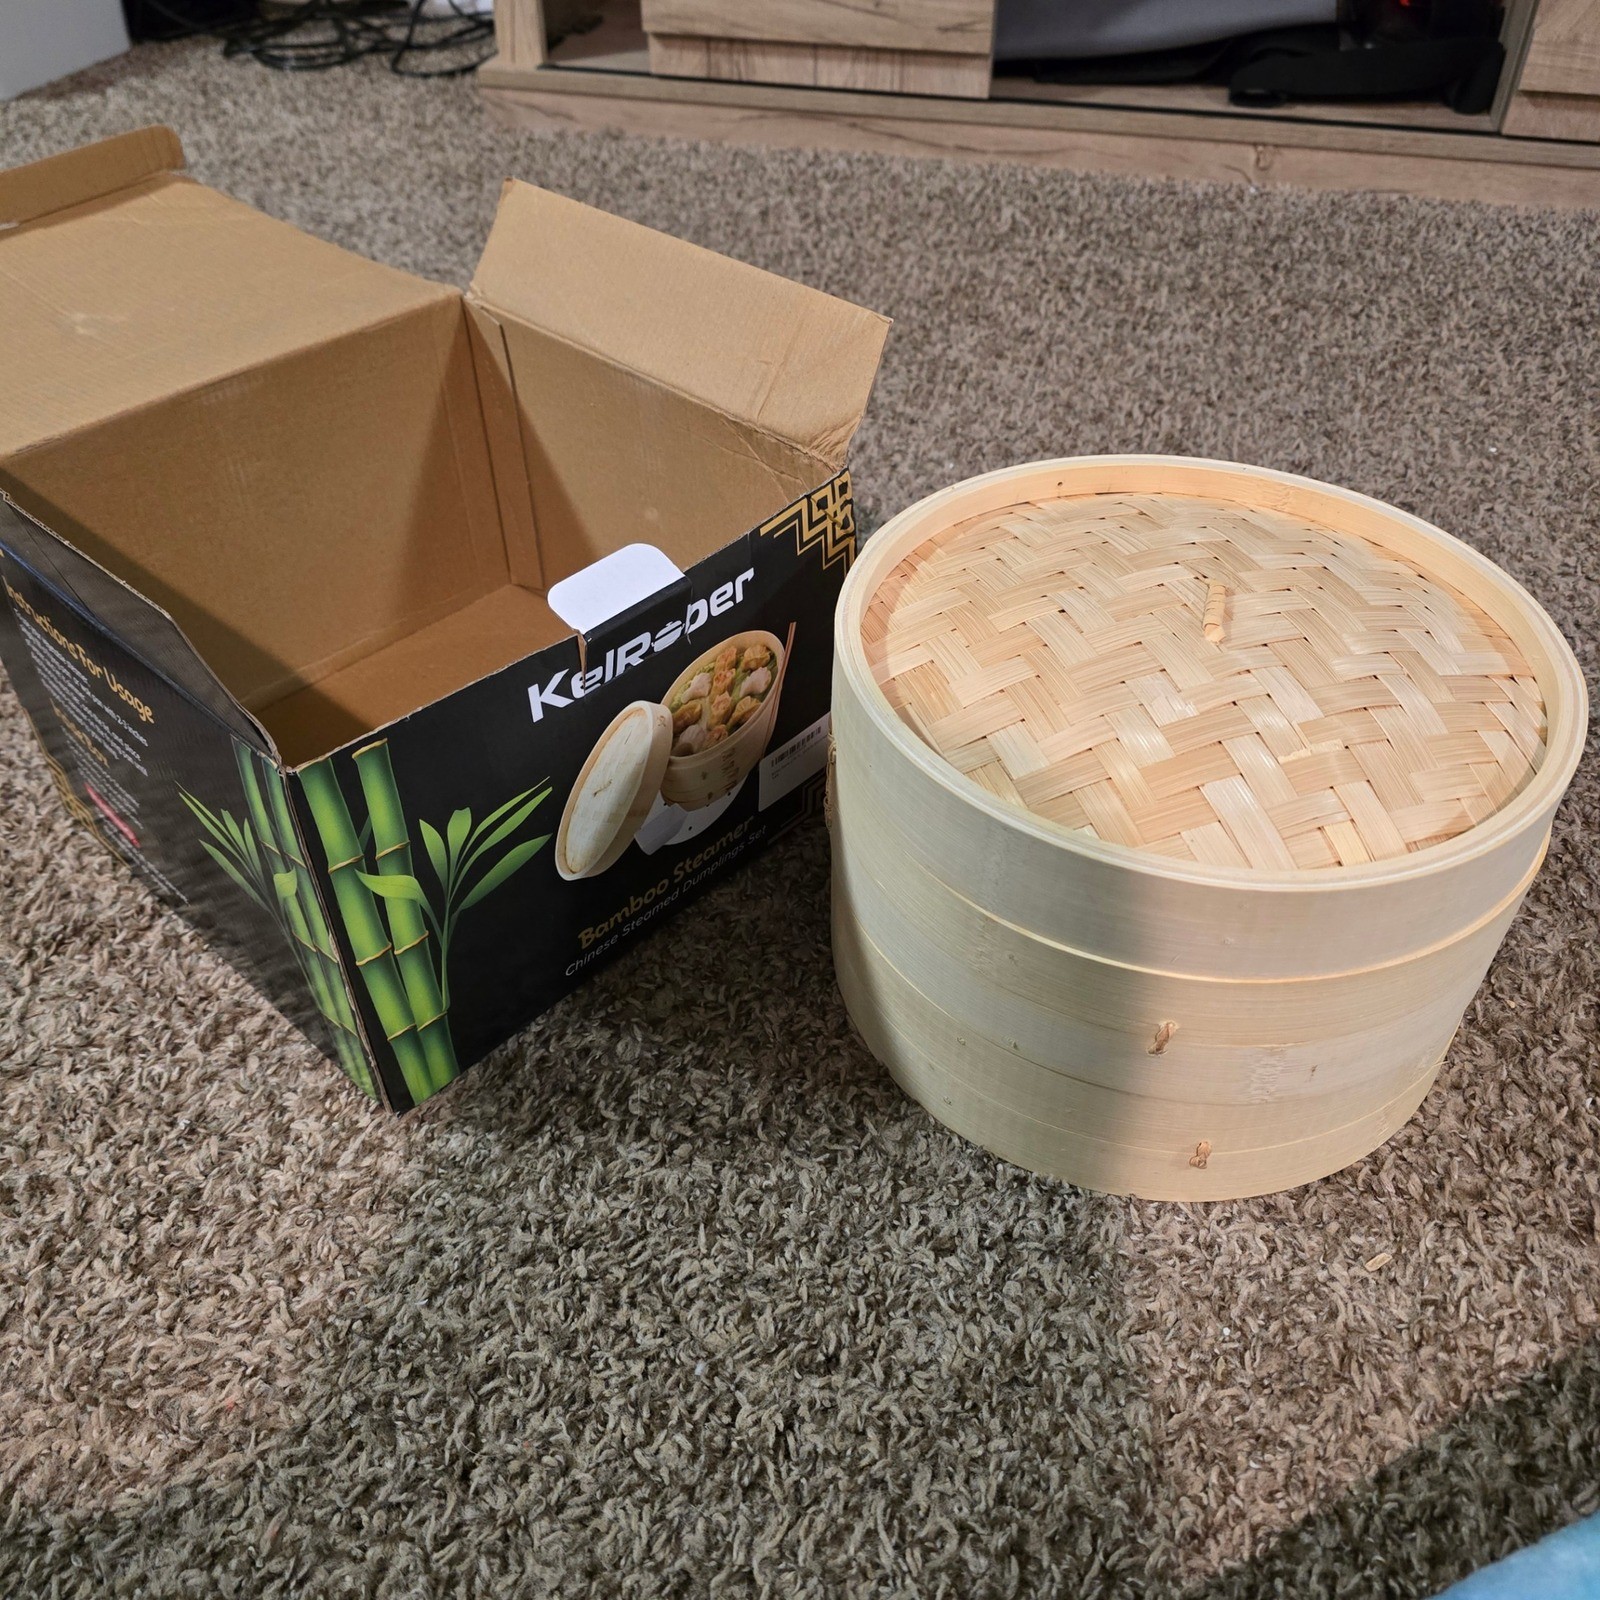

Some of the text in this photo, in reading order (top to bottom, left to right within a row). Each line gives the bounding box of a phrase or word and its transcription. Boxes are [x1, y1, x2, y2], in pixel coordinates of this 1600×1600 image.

[74, 643, 103, 678] For
[103, 666, 155, 724] Usage
[565, 825, 767, 976] Chinese Steamed Dumplings Set
[578, 815, 755, 950] Bamboo Steamer
